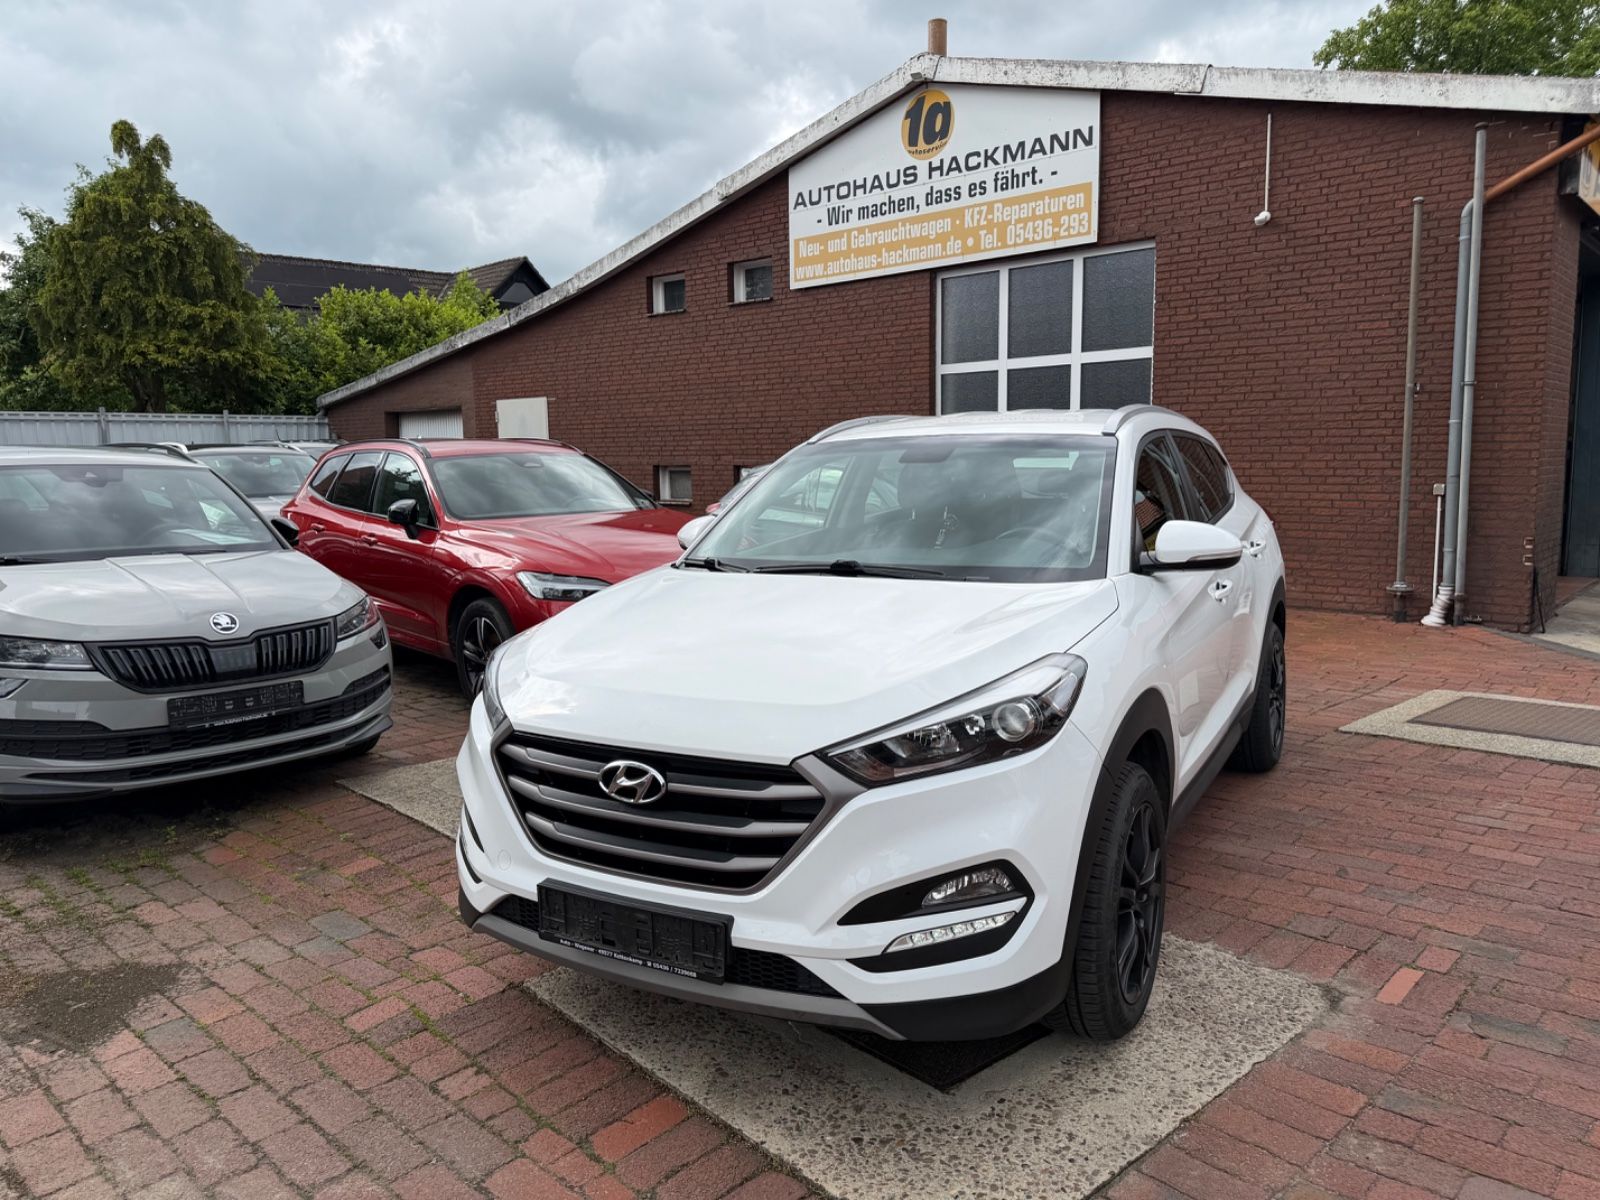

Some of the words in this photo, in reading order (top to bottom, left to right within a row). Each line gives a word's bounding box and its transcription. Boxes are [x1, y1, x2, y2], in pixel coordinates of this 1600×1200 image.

[793, 165, 918, 210] AUTOHAUS
[928, 125, 1094, 180] HACKMANN
[827, 204, 853, 226] Wir
[858, 195, 920, 221] machen,
[925, 185, 962, 207] dass
[968, 179, 987, 198] es
[993, 166, 1043, 193] fährt.
[795, 236, 962, 279] www.autohaus-hackmann.de
[979, 228, 1001, 250] Tel.
[1006, 212, 1089, 245] 05436-293
[799, 240, 825, 258] Neu-
[828, 232, 847, 253] und
[851, 217, 951, 249] Gebrauchtwagen
[964, 192, 1085, 229] KFZ-Reparaturen
